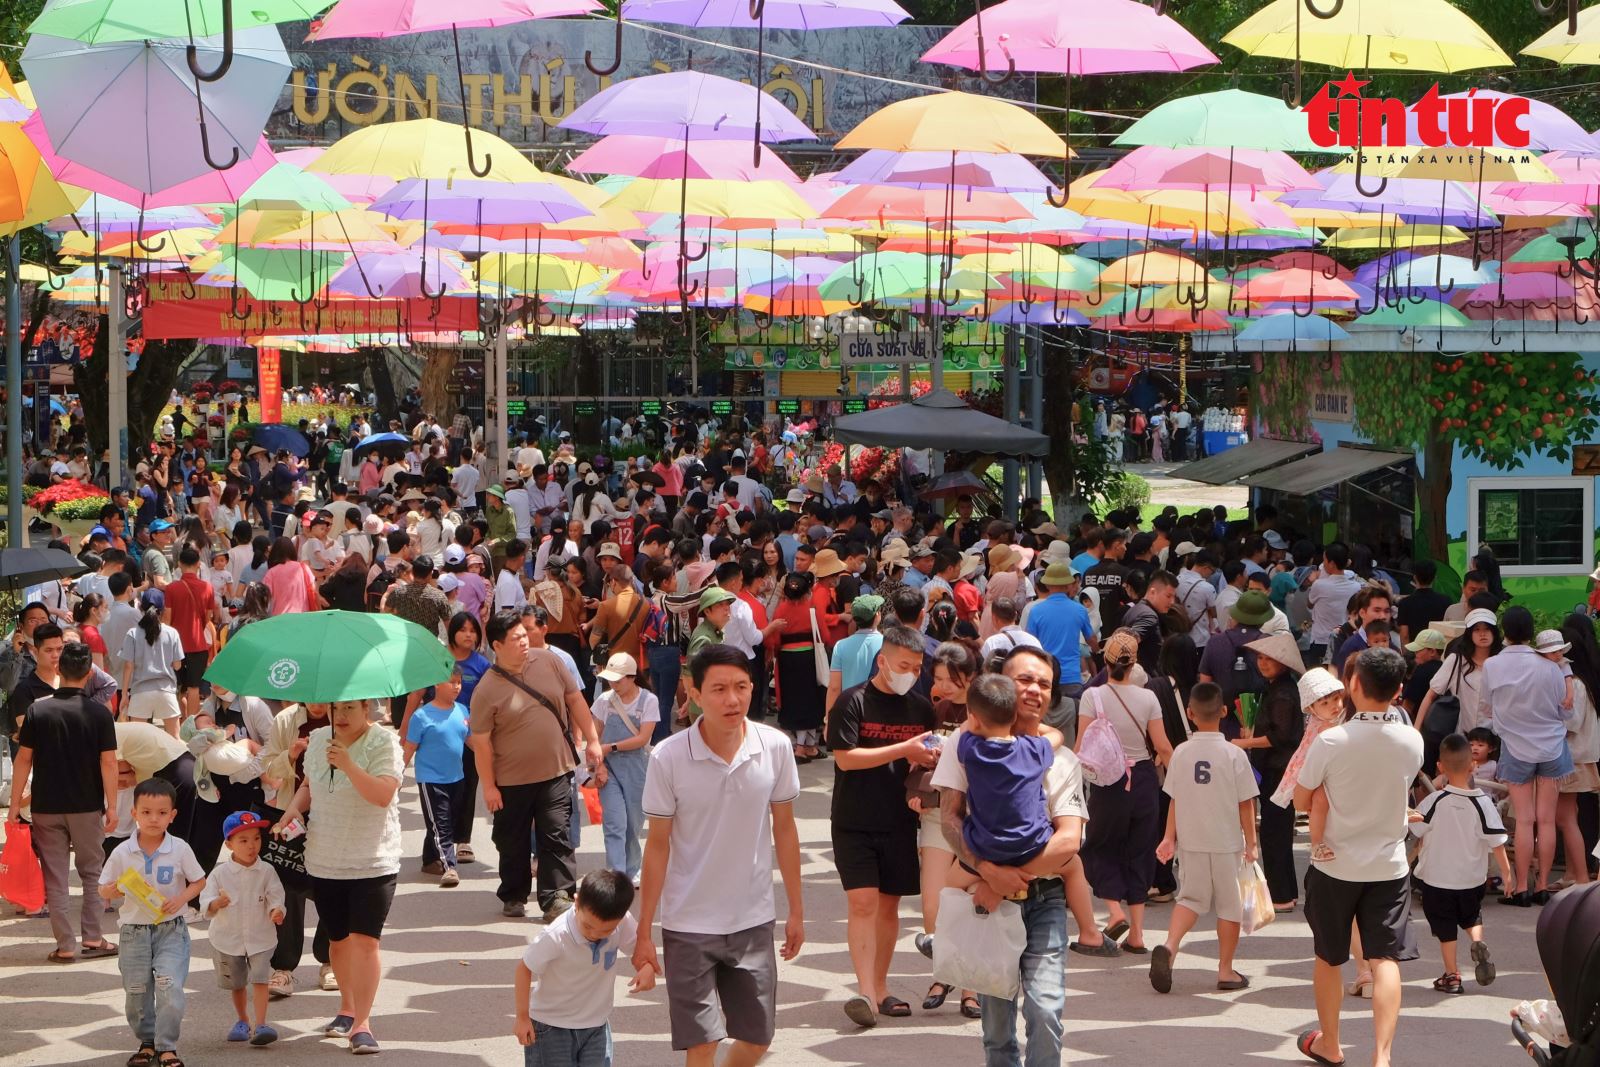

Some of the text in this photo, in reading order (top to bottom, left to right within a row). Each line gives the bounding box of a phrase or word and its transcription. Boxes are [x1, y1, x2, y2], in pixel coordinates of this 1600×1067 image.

[292, 55, 439, 126] ƯỜN
[465, 57, 575, 127] THÚ
[618, 527, 632, 545] 12
[1085, 574, 1122, 586] BEAVER
[1194, 760, 1211, 785] 6
[262, 852, 309, 876] ARTIS
